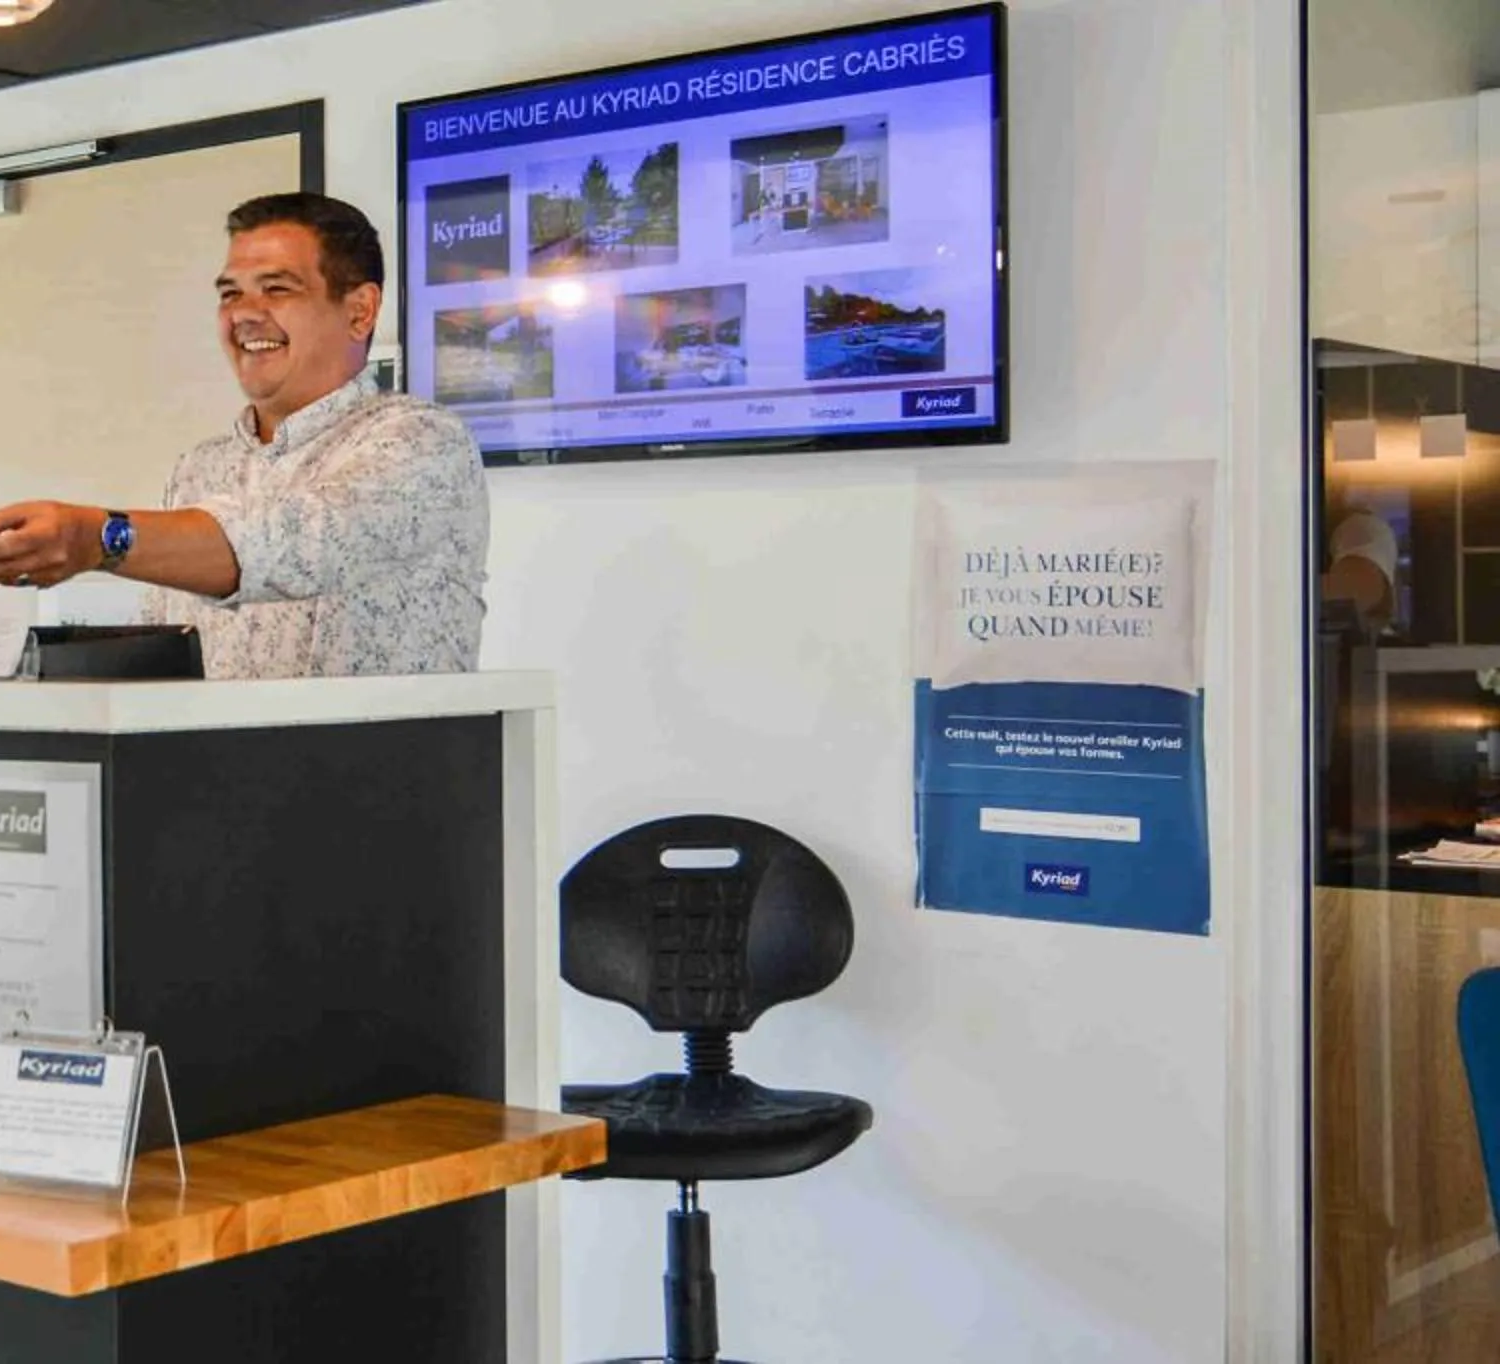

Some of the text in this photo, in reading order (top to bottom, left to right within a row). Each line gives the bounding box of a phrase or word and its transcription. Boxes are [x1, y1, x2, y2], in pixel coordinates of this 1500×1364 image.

[425, 33, 966, 142] BIENVENUE AU KYRIAD RÉSIDENCE CABRIÈS
[432, 212, 503, 250] Kyriad
[916, 393, 962, 410] Kyriad
[965, 546, 1164, 579] DÉJÀ MARIÉ(E)?
[959, 579, 1164, 608] JE VOUS ÉPOUSE
[967, 614, 1154, 641] QUAND MÊME!
[945, 728, 976, 740] Cette
[1055, 733, 1095, 746] nouvel
[1142, 736, 1182, 751] Kyriad
[1031, 869, 1082, 887] Kyriad
[20, 1056, 103, 1078] Kyriad
